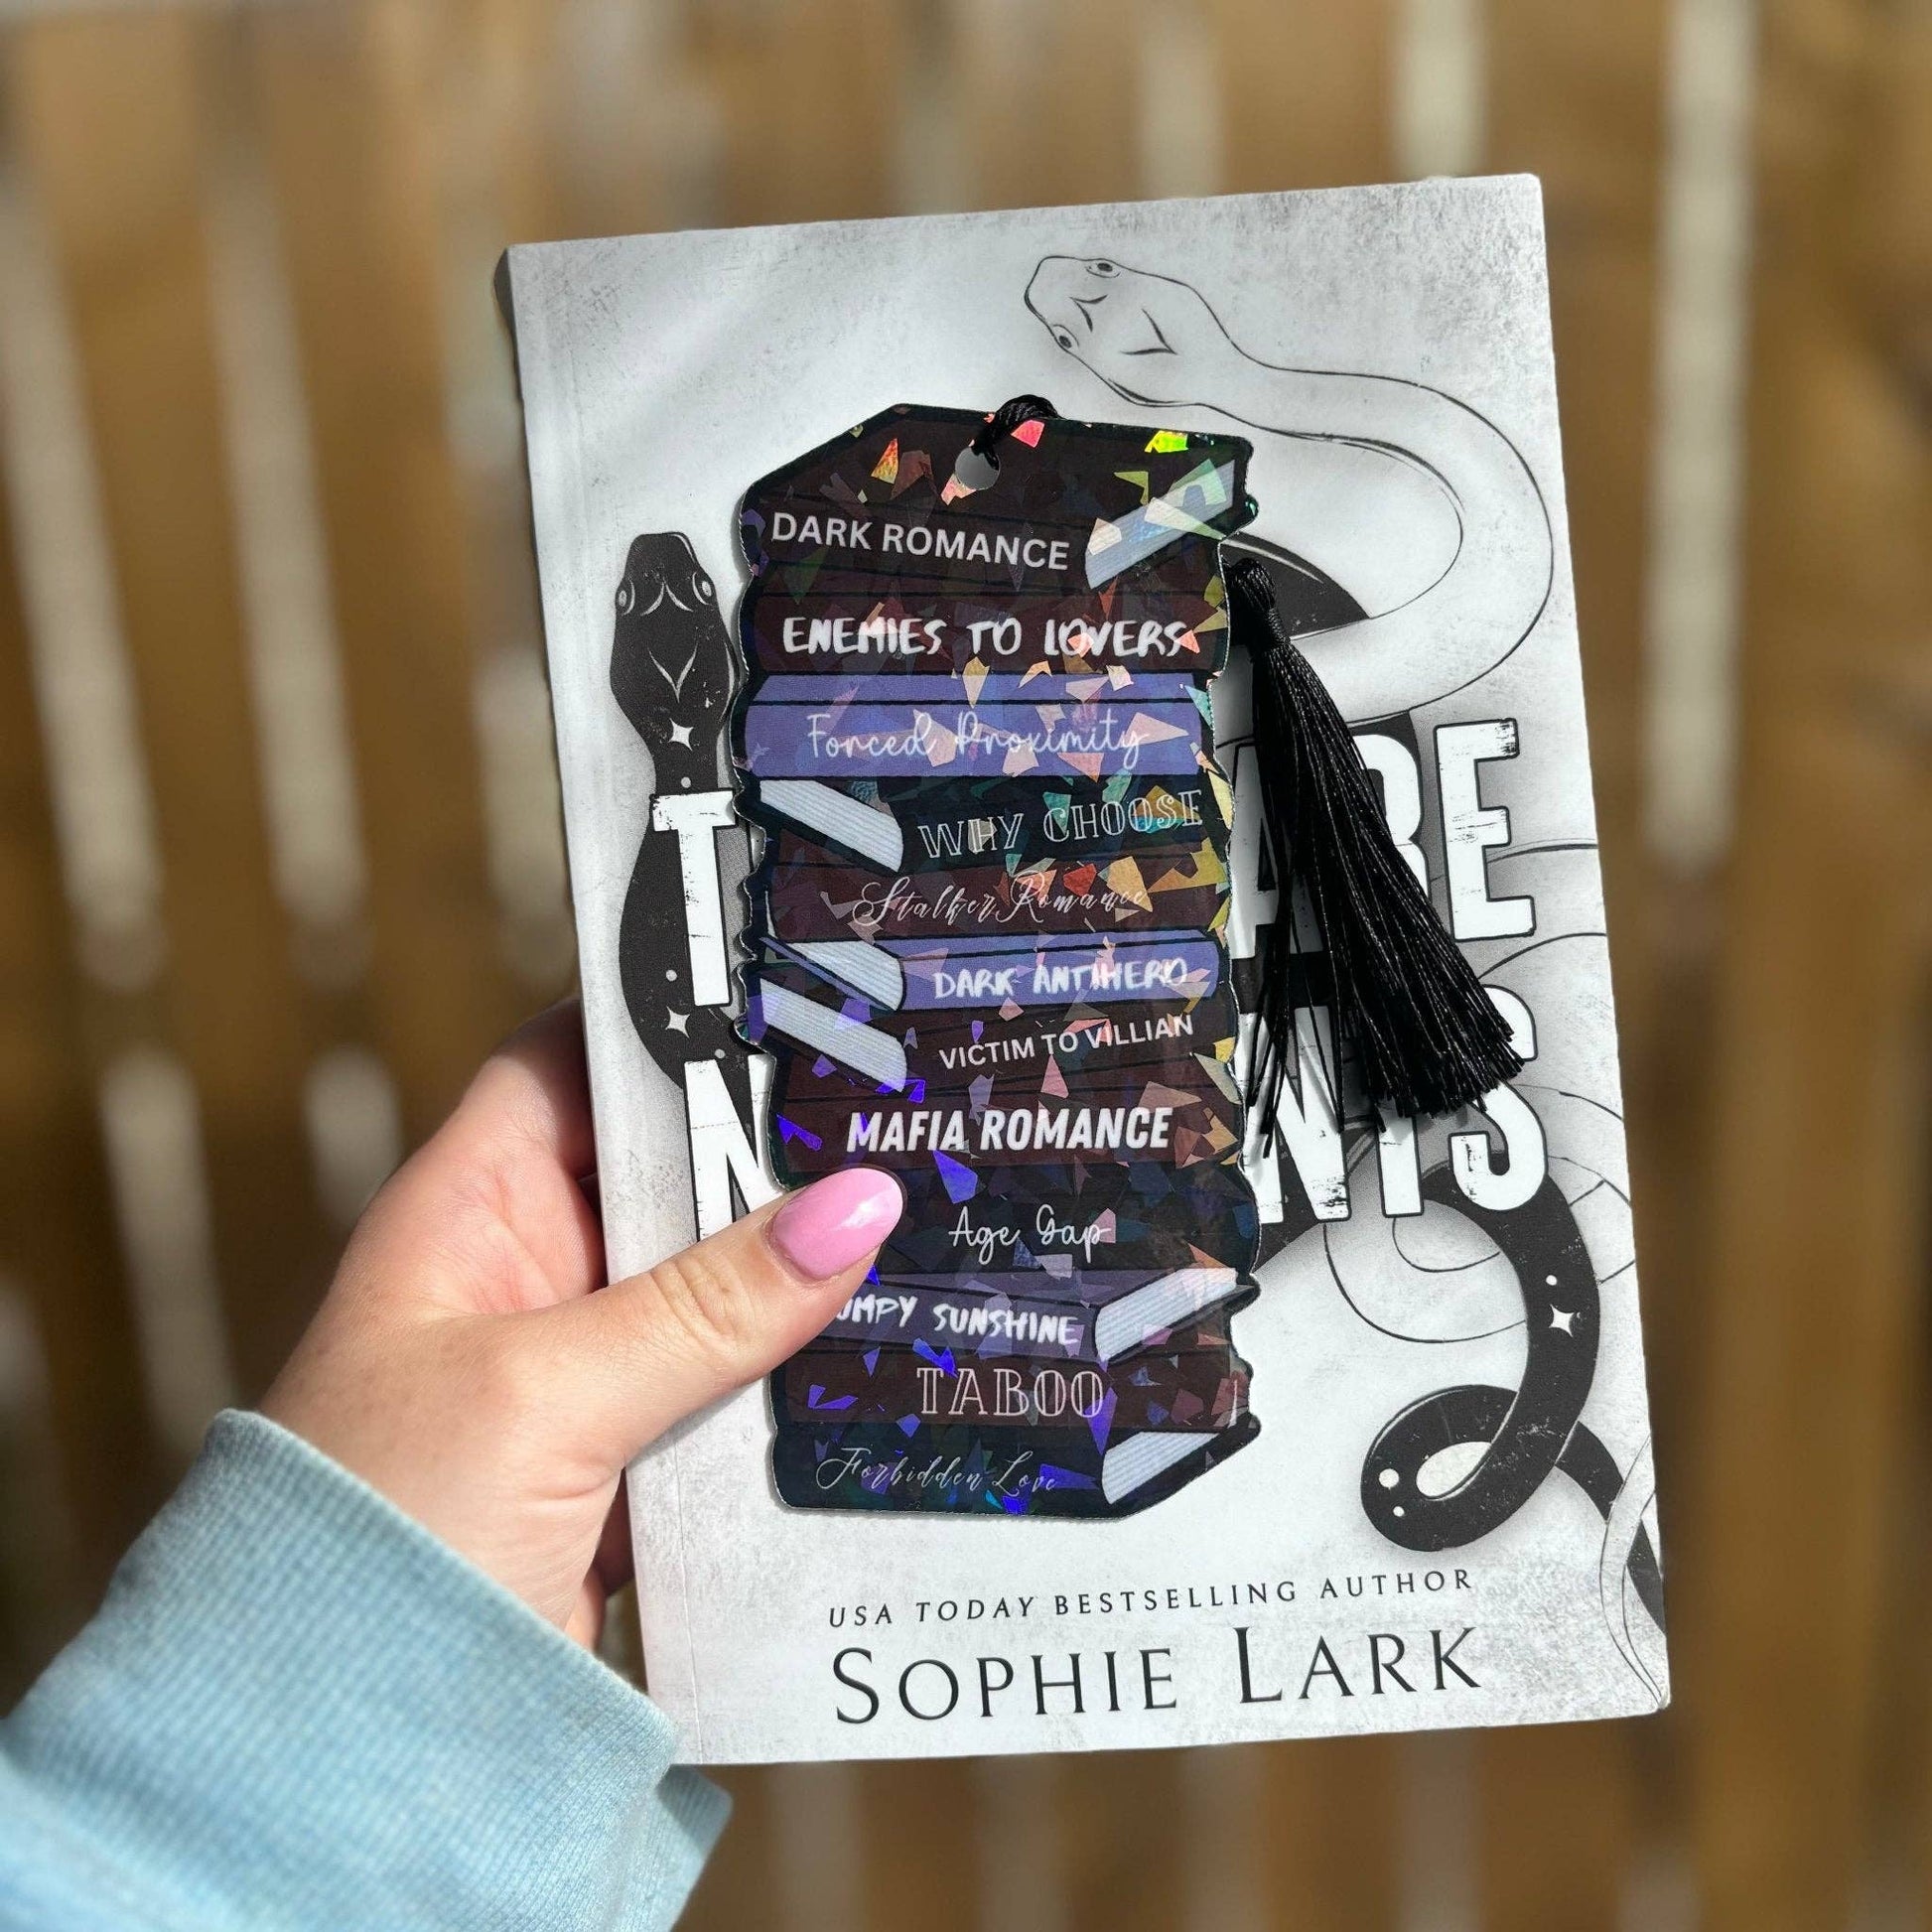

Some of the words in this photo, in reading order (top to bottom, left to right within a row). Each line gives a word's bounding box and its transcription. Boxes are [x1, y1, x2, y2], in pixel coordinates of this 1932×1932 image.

[770, 511, 872, 551] DARK
[882, 523, 1070, 572] ROMANCE
[782, 617, 948, 656] ENEMIES
[965, 618, 1022, 656] TO
[1043, 616, 1191, 658] LOVERS
[806, 709, 937, 759] Forced
[954, 709, 1152, 770] Proximity
[917, 810, 1024, 860] WHY
[1042, 788, 1203, 841] CHOOSE
[852, 876, 996, 927] Stalker
[996, 870, 1149, 923] Romance
[933, 968, 1018, 1000] DARK
[1032, 956, 1189, 995] ANTIHERO
[938, 1035, 1035, 1071] VICTIM
[1040, 1031, 1079, 1054] TO
[1088, 1013, 1195, 1049] VILLIAN
[846, 1109, 967, 1154] MAFIA
[978, 1106, 1174, 1151] ROMANCE
[948, 1206, 1022, 1266] Age
[1035, 1204, 1113, 1267] Gap
[932, 1303, 1081, 1346] SUNSHINE
[915, 1366, 1105, 1419] TABOO
[816, 1447, 983, 1490] Forbidden
[991, 1450, 1058, 1497] Love
[829, 1604, 894, 1629] USA
[916, 1595, 1035, 1623] TODAY
[1054, 1580, 1299, 1616] BESTSELLING
[1318, 1567, 1473, 1599] AUTHOR
[831, 1645, 1178, 1725] SOPHIE
[1232, 1625, 1482, 1705] LARK
